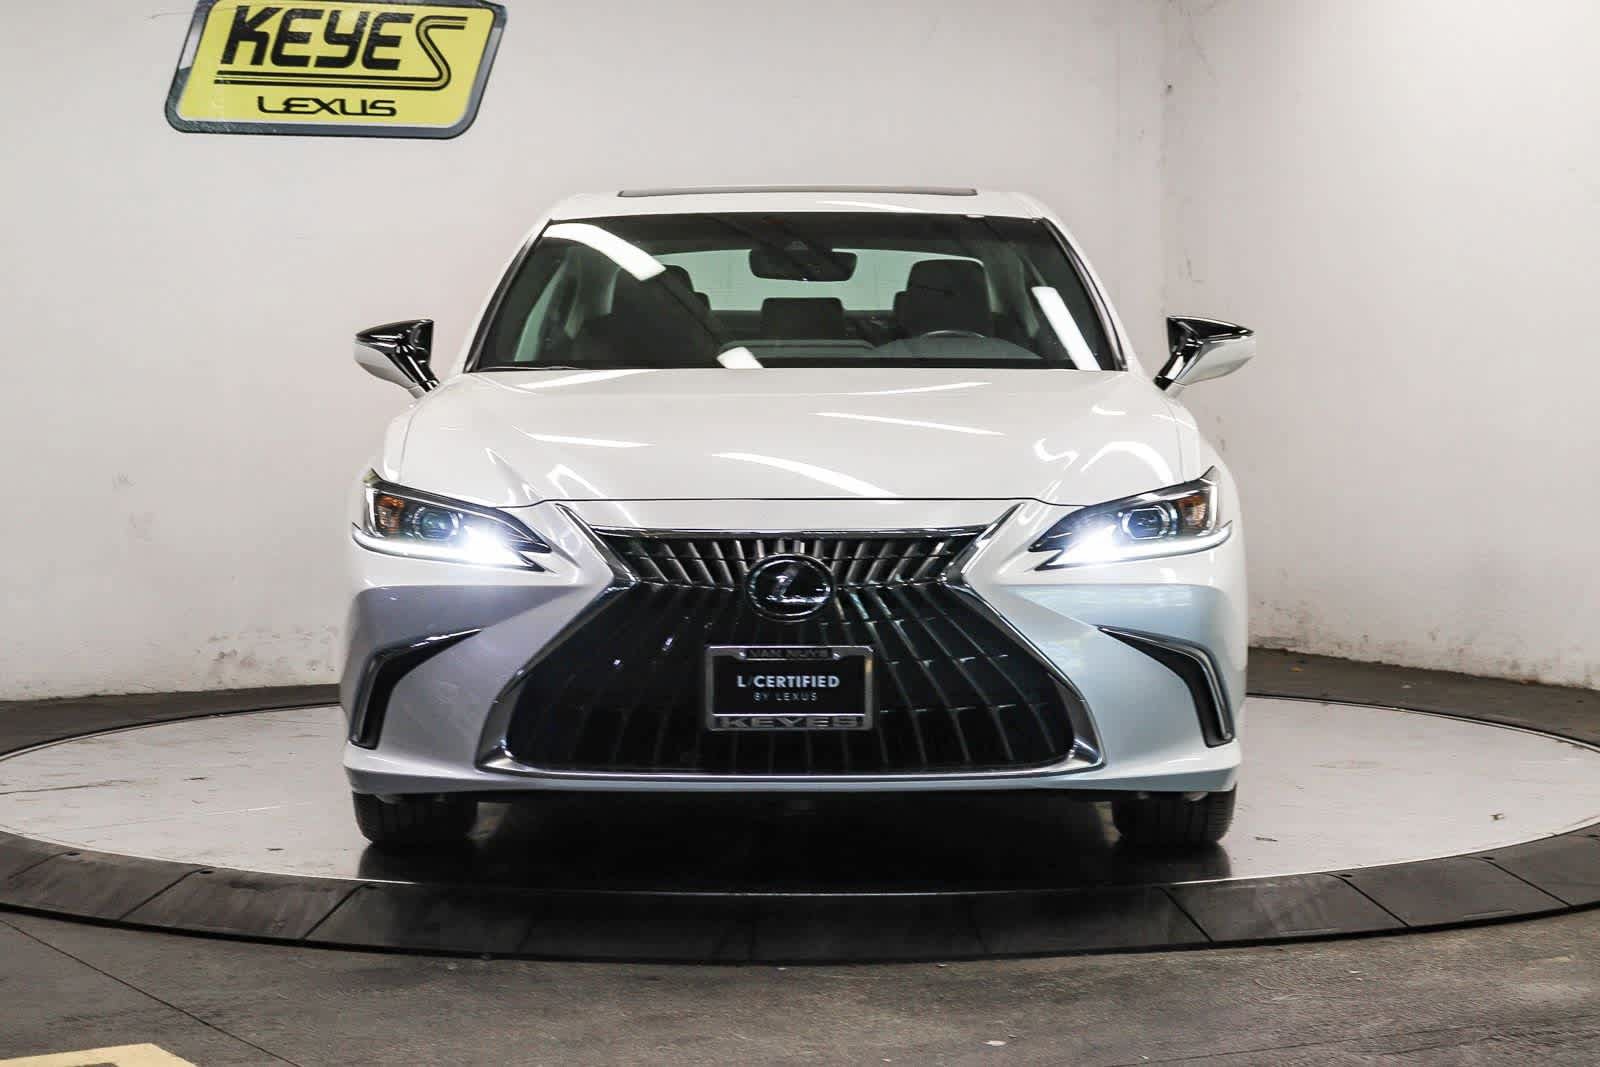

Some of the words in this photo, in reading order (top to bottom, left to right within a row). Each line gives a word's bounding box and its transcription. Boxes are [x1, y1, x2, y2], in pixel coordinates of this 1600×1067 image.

[219, 5, 468, 91] KEYES
[257, 96, 397, 117] LEXUS
[753, 692, 769, 701] BY
[776, 692, 817, 701] LEXUS
[719, 716, 860, 729] KEYES
